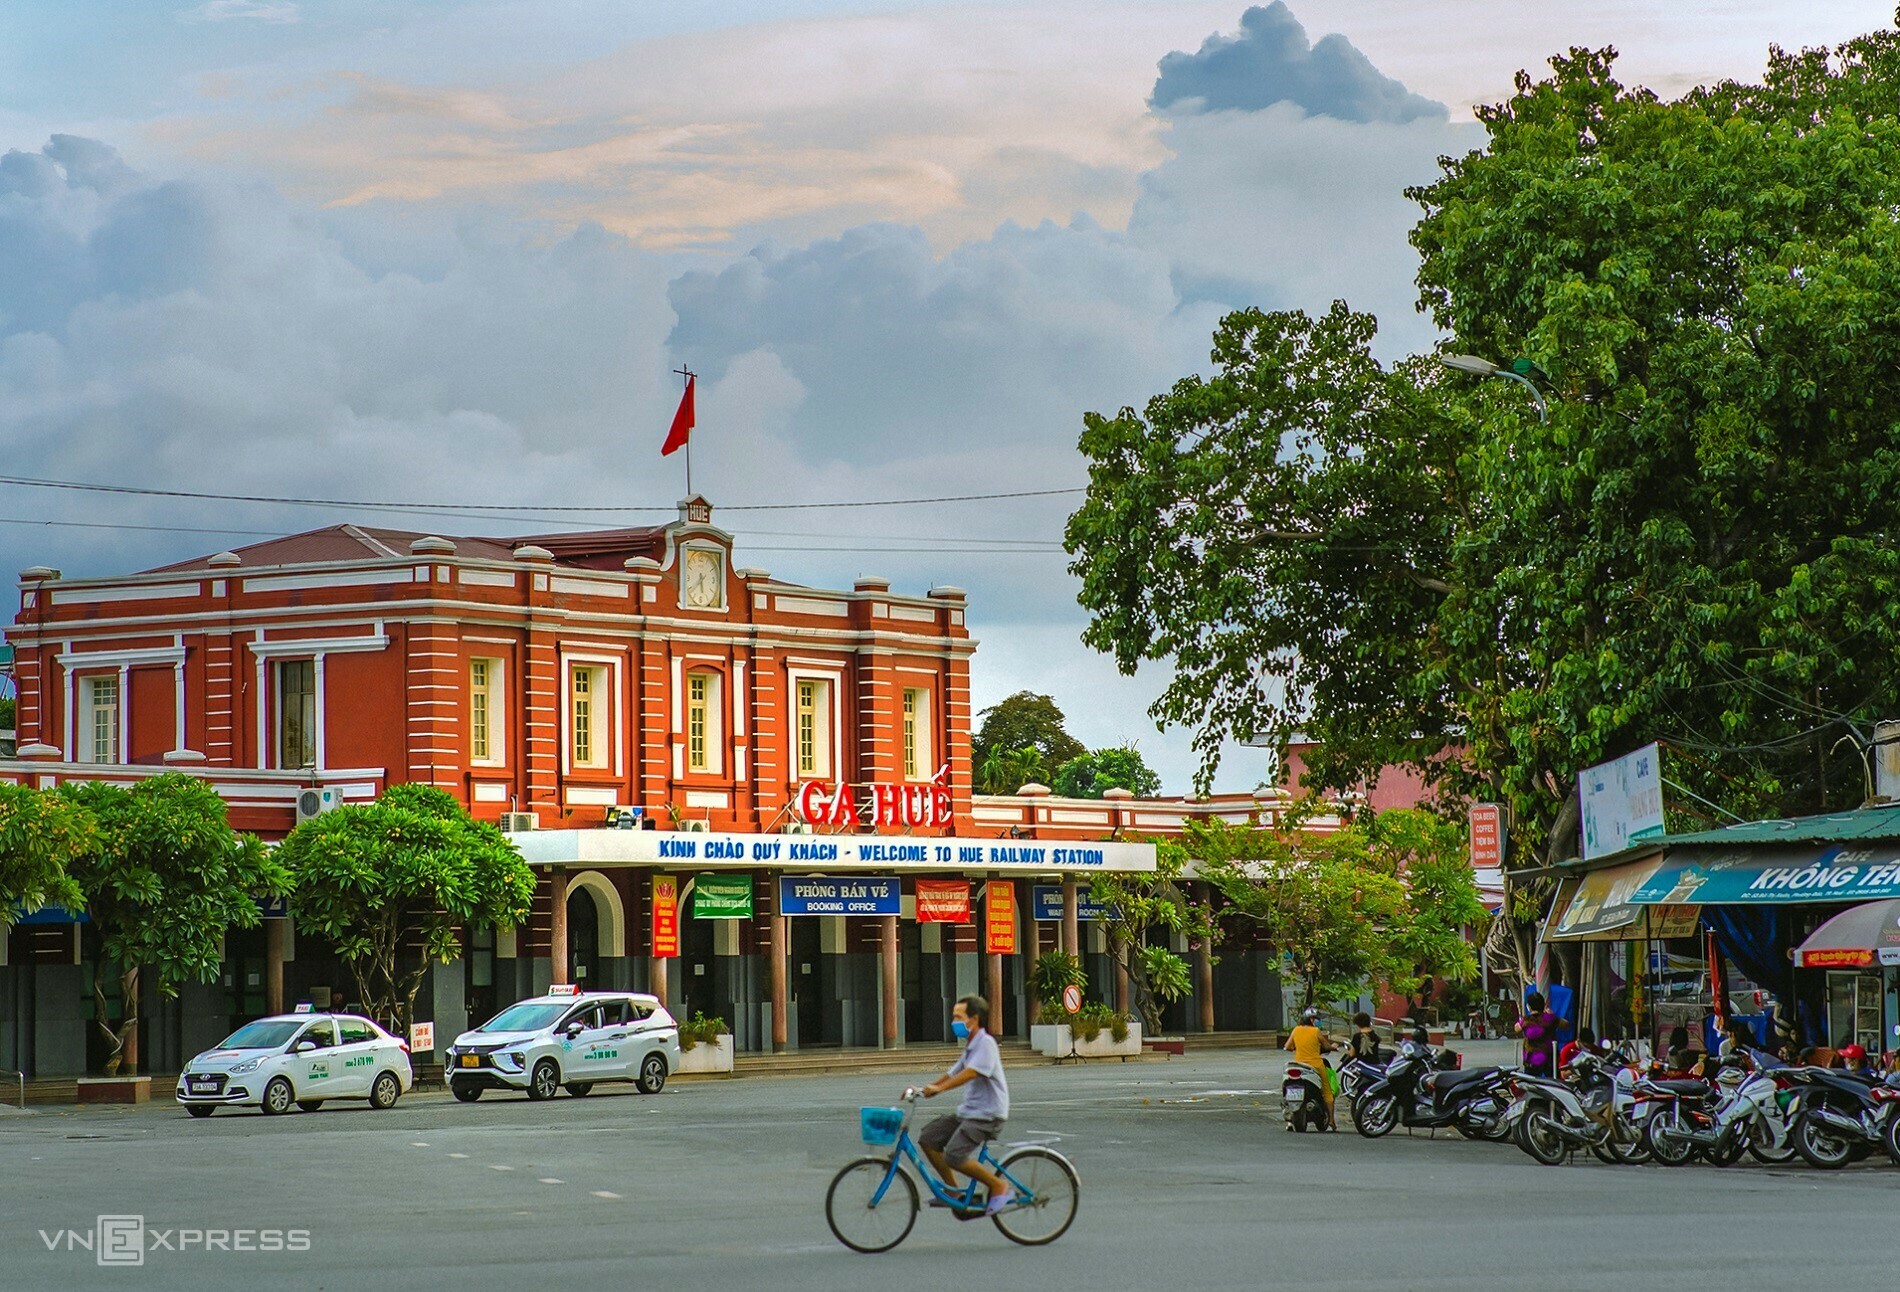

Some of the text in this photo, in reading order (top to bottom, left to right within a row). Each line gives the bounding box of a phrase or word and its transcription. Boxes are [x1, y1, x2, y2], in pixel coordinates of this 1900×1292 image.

[689, 504, 708, 521] HUE
[799, 763, 954, 828] GA HUẾ
[1483, 812, 1496, 821] BEER
[1475, 824, 1494, 834] COFFEE
[658, 835, 697, 858] KÍNH
[753, 838, 782, 862] QUÝ
[789, 839, 838, 861] KHÁCH
[859, 845, 928, 862] WELCOME
[935, 846, 951, 862] TO
[958, 847, 984, 863] HUE
[989, 848, 1046, 864] RAILWAY
[1053, 849, 1104, 865] STATION
[1749, 862, 1859, 889] KHÔNG
[795, 881, 889, 898] PHÒNG BÁN VÉ
[807, 902, 877, 911] BOOKING OFFICE
